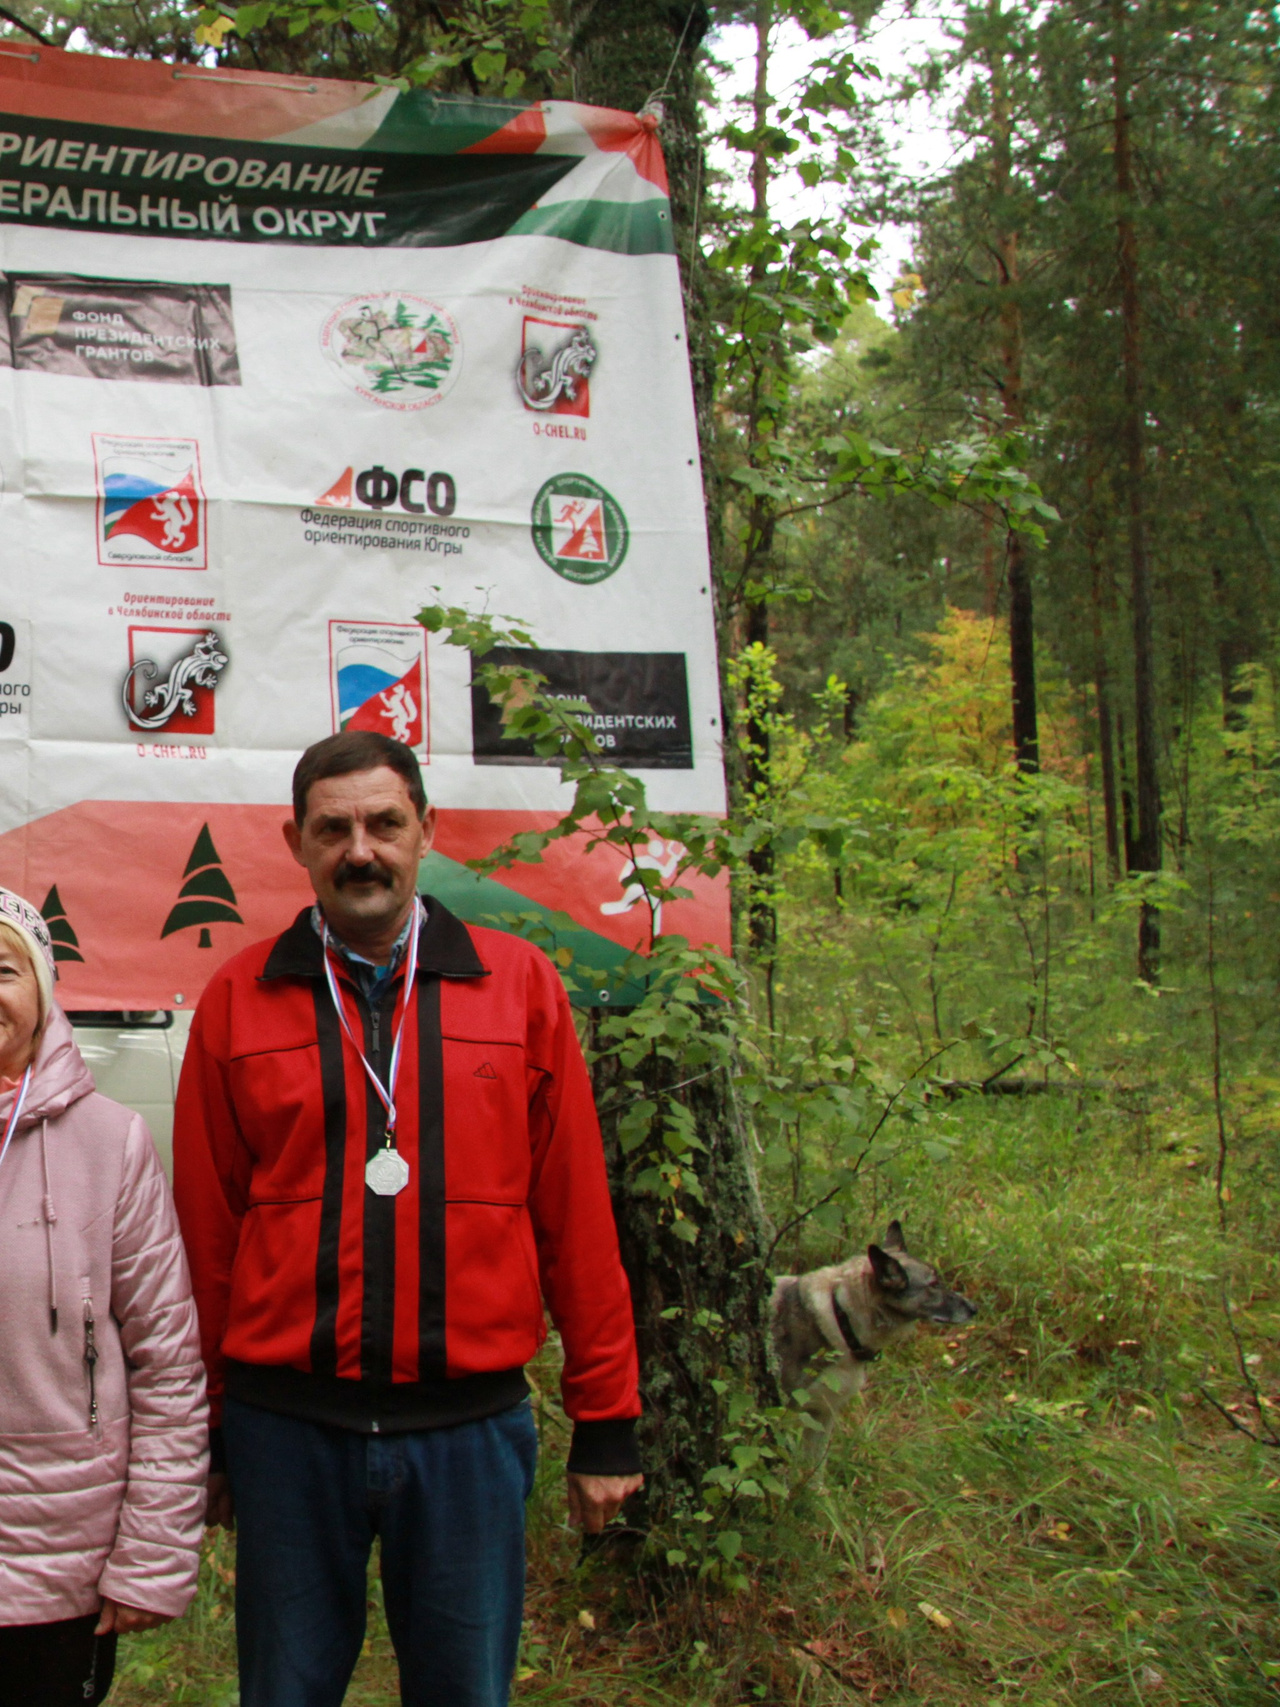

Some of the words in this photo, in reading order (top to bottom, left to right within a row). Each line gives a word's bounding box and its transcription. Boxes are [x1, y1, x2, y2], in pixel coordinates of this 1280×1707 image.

[253, 206, 386, 239] ОКРУГ
[72, 311, 125, 327] ФОНД
[74, 327, 220, 350] ПРЕЗИДЕНТСКИХ
[75, 345, 155, 362] ГРАНТОВ
[355, 465, 456, 517] ФСО
[300, 507, 382, 531] Федерация
[385, 518, 470, 538] спортивного
[304, 529, 420, 550] ориентирования
[424, 537, 463, 557] Югры
